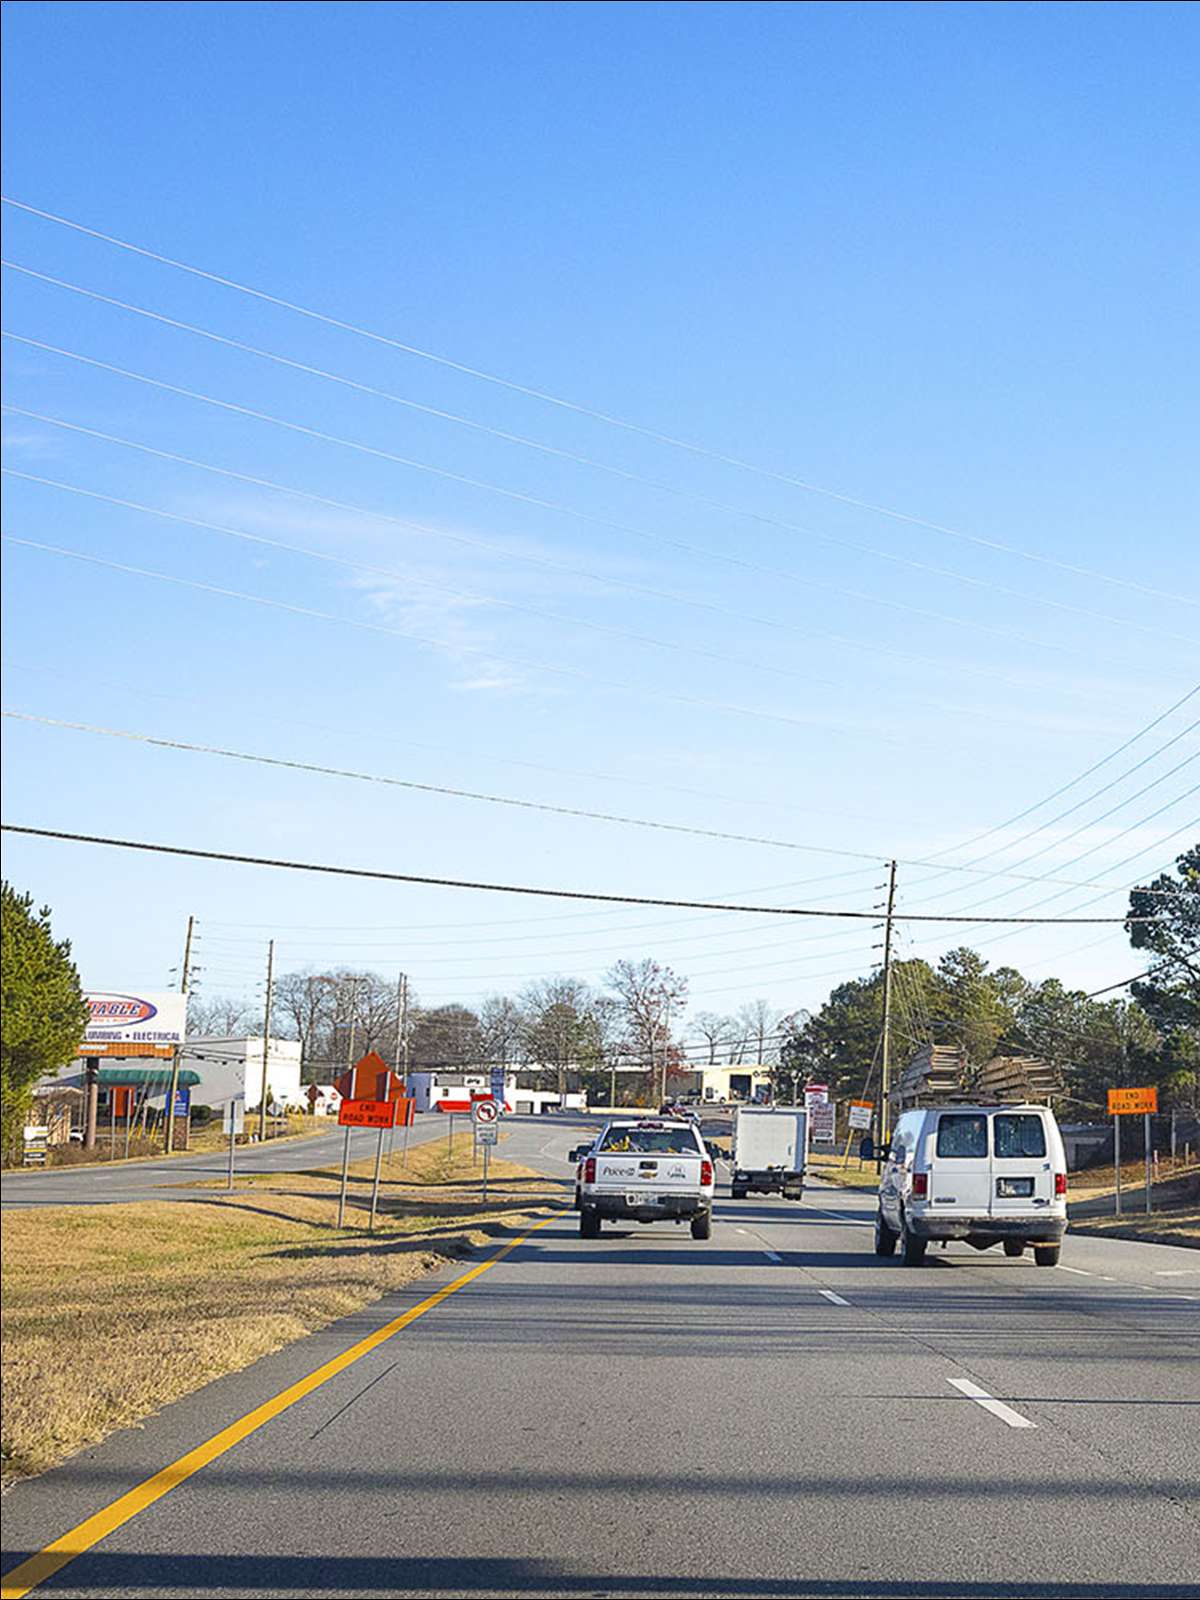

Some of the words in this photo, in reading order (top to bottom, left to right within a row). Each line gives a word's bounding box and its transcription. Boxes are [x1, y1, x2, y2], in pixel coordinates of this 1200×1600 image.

[89, 1003, 141, 1015] IABLE
[132, 1031, 180, 1041] ELECTRICAL
[1125, 1091, 1139, 1100] END
[359, 1103, 377, 1112] END
[1112, 1102, 1131, 1110] ROAD
[1134, 1101, 1153, 1110] WORK
[343, 1113, 365, 1122] ROAD
[367, 1115, 390, 1124] WORK
